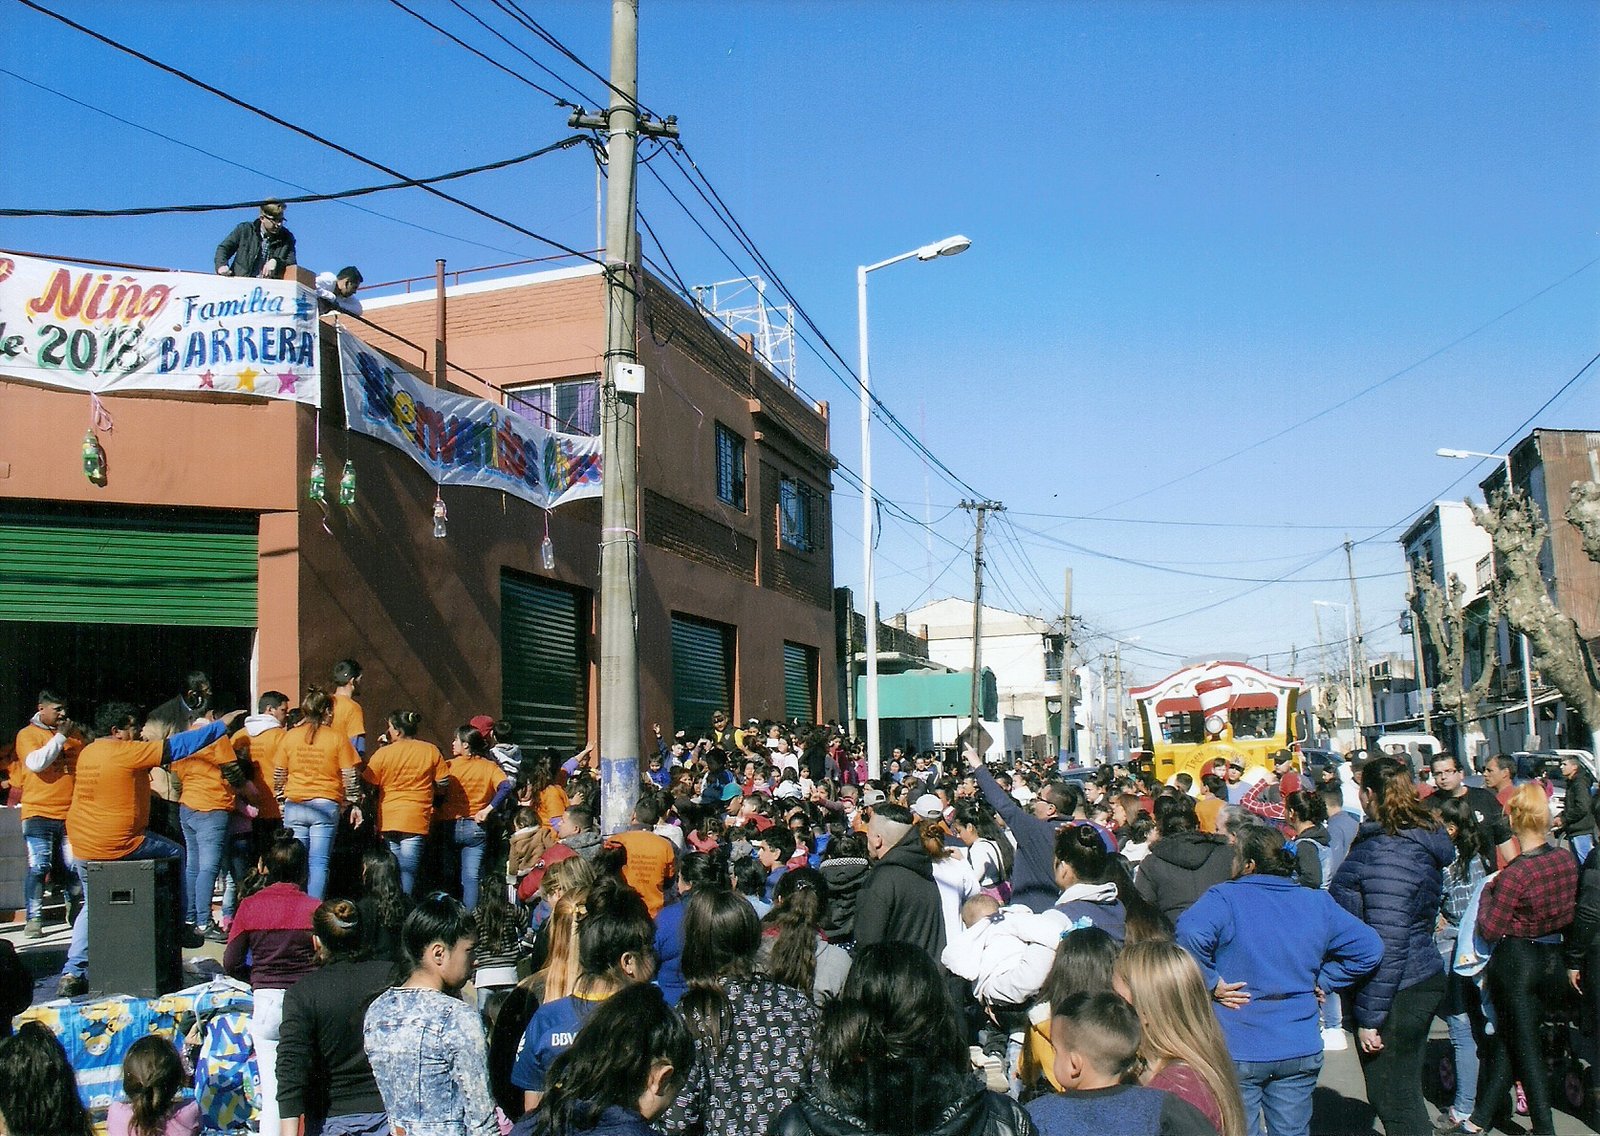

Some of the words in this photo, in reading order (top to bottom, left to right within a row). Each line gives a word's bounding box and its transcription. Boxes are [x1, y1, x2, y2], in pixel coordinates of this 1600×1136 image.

[27, 267, 173, 324] Niño
[184, 286, 284, 326] Familia
[158, 326, 314, 374] BARRERA
[551, 1031, 578, 1047] BBV
